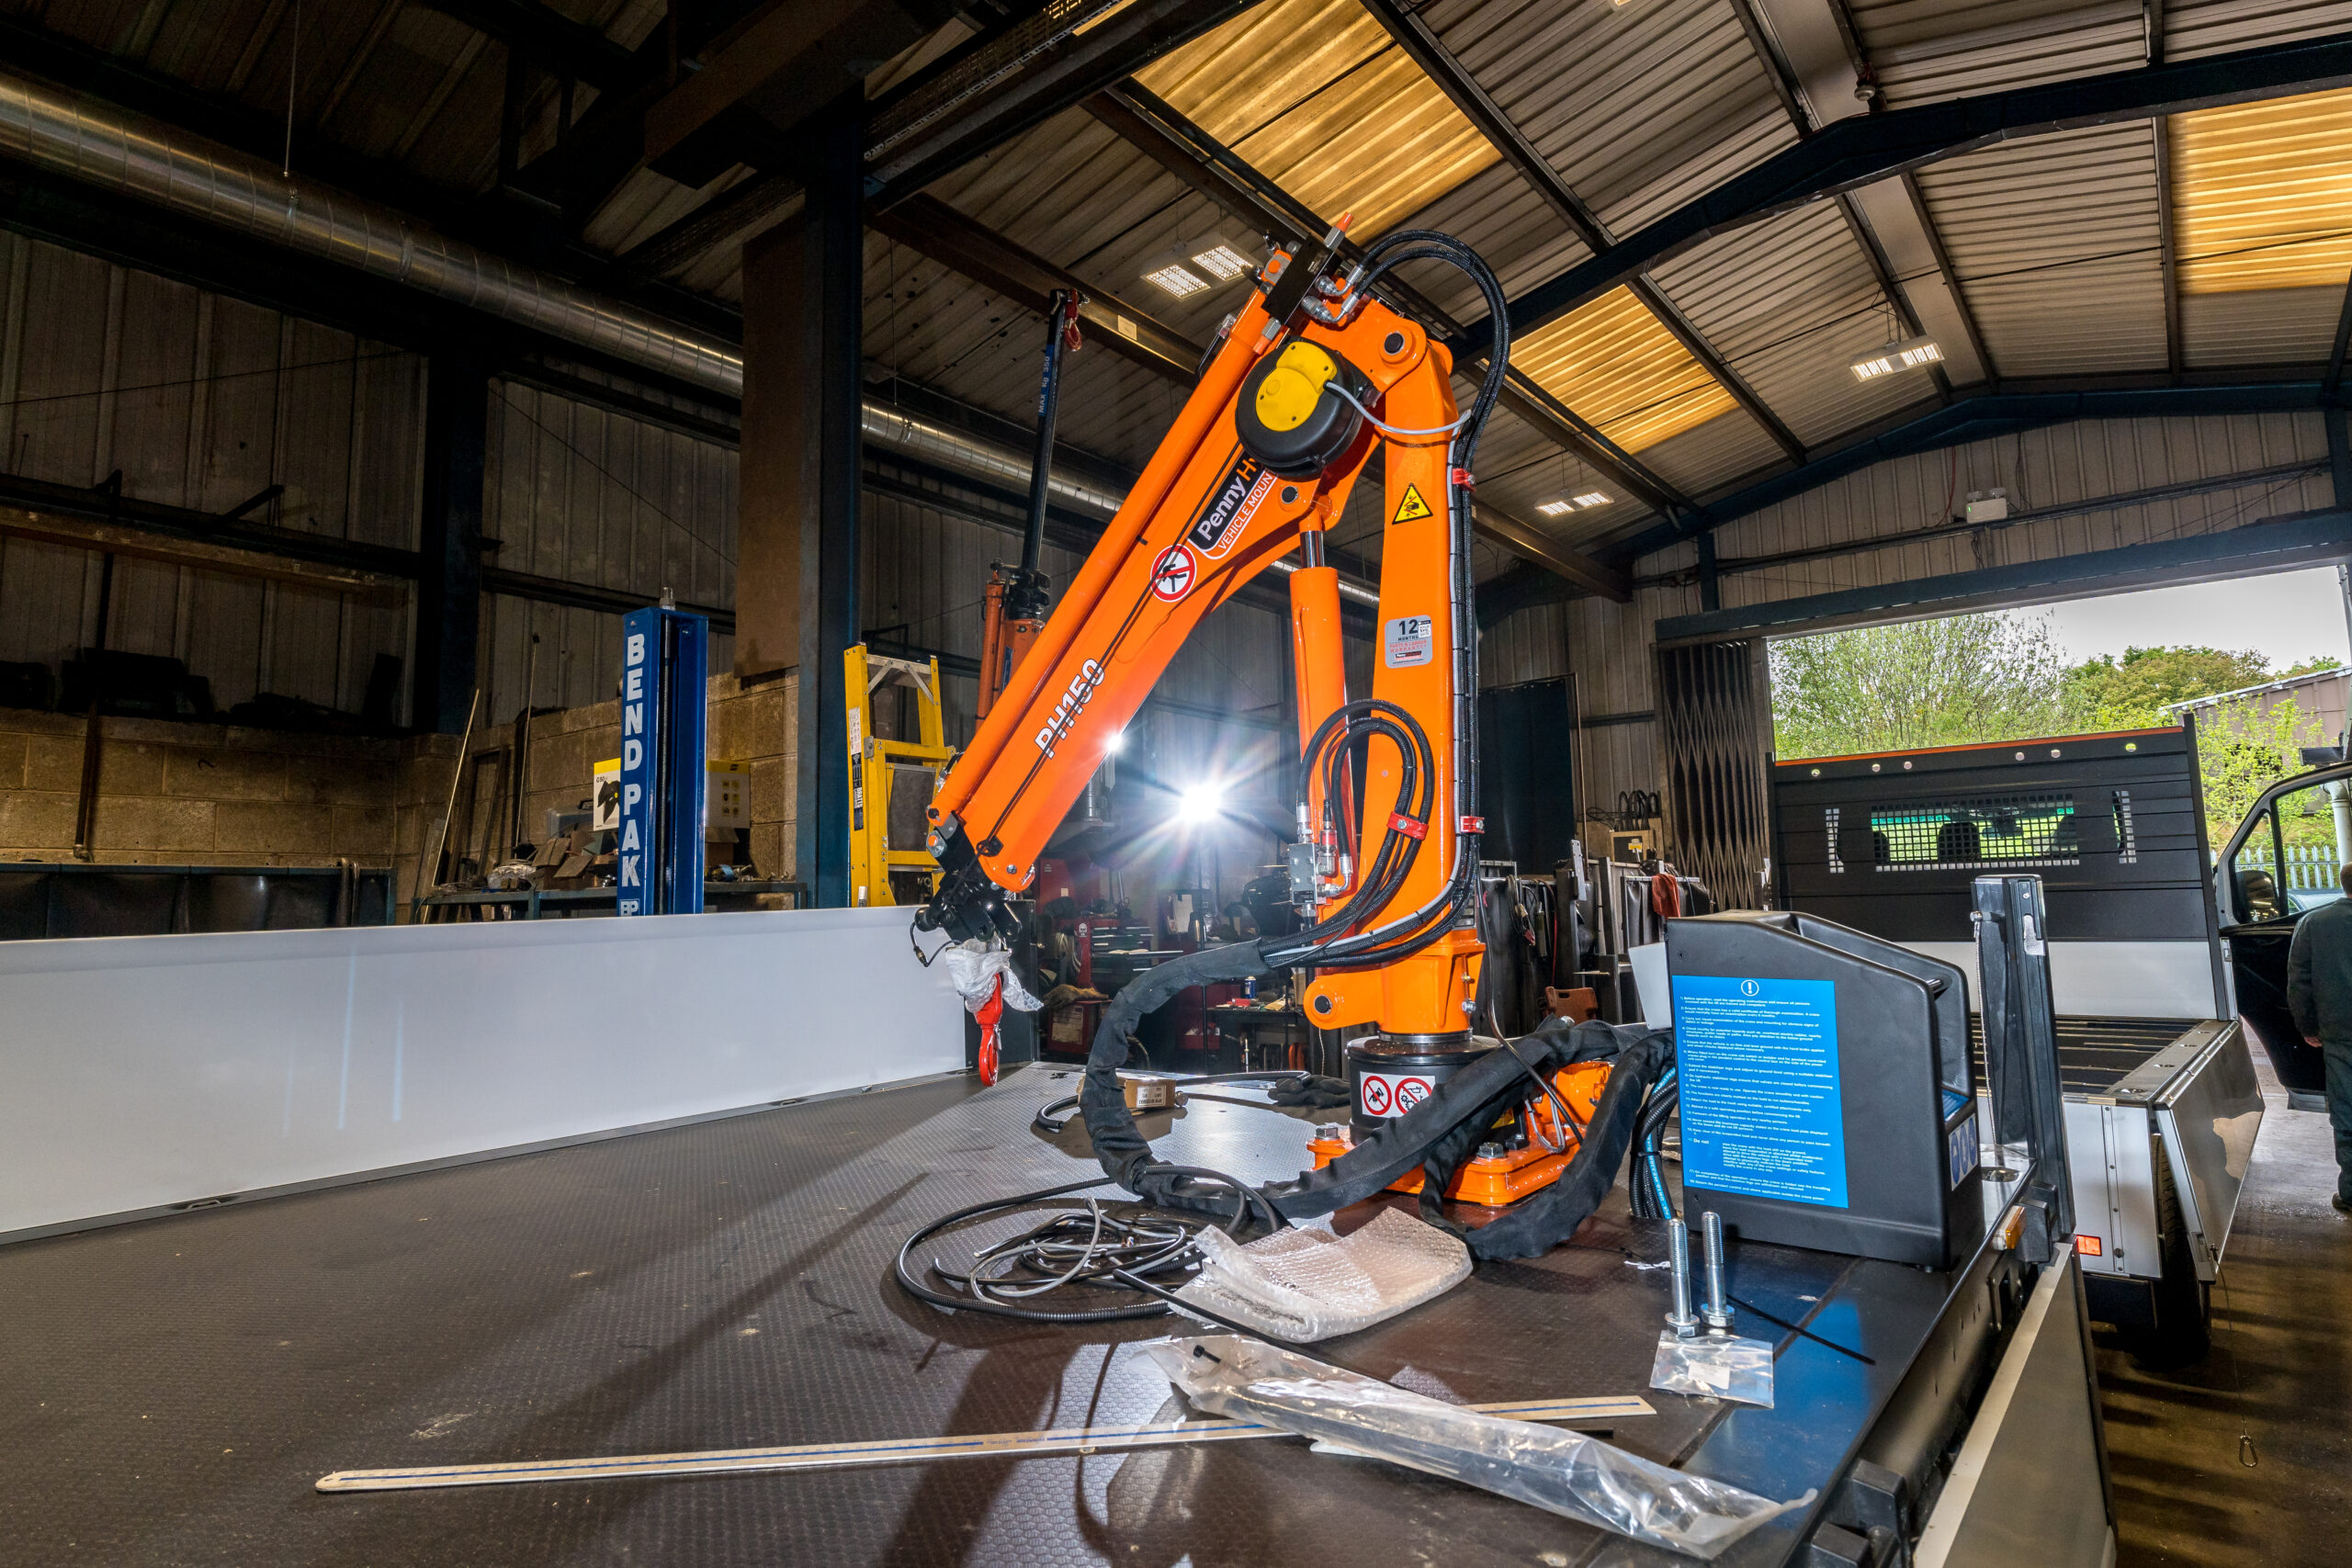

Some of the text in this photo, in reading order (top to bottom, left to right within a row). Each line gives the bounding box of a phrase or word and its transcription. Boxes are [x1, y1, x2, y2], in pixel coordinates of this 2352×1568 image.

[1196, 457, 1258, 541] Penny H
[1218, 507, 1251, 550] VEHICLE
[1398, 618, 1419, 635] 12
[1034, 658, 1105, 760] PH150
[621, 633, 645, 887] BEND PAK
